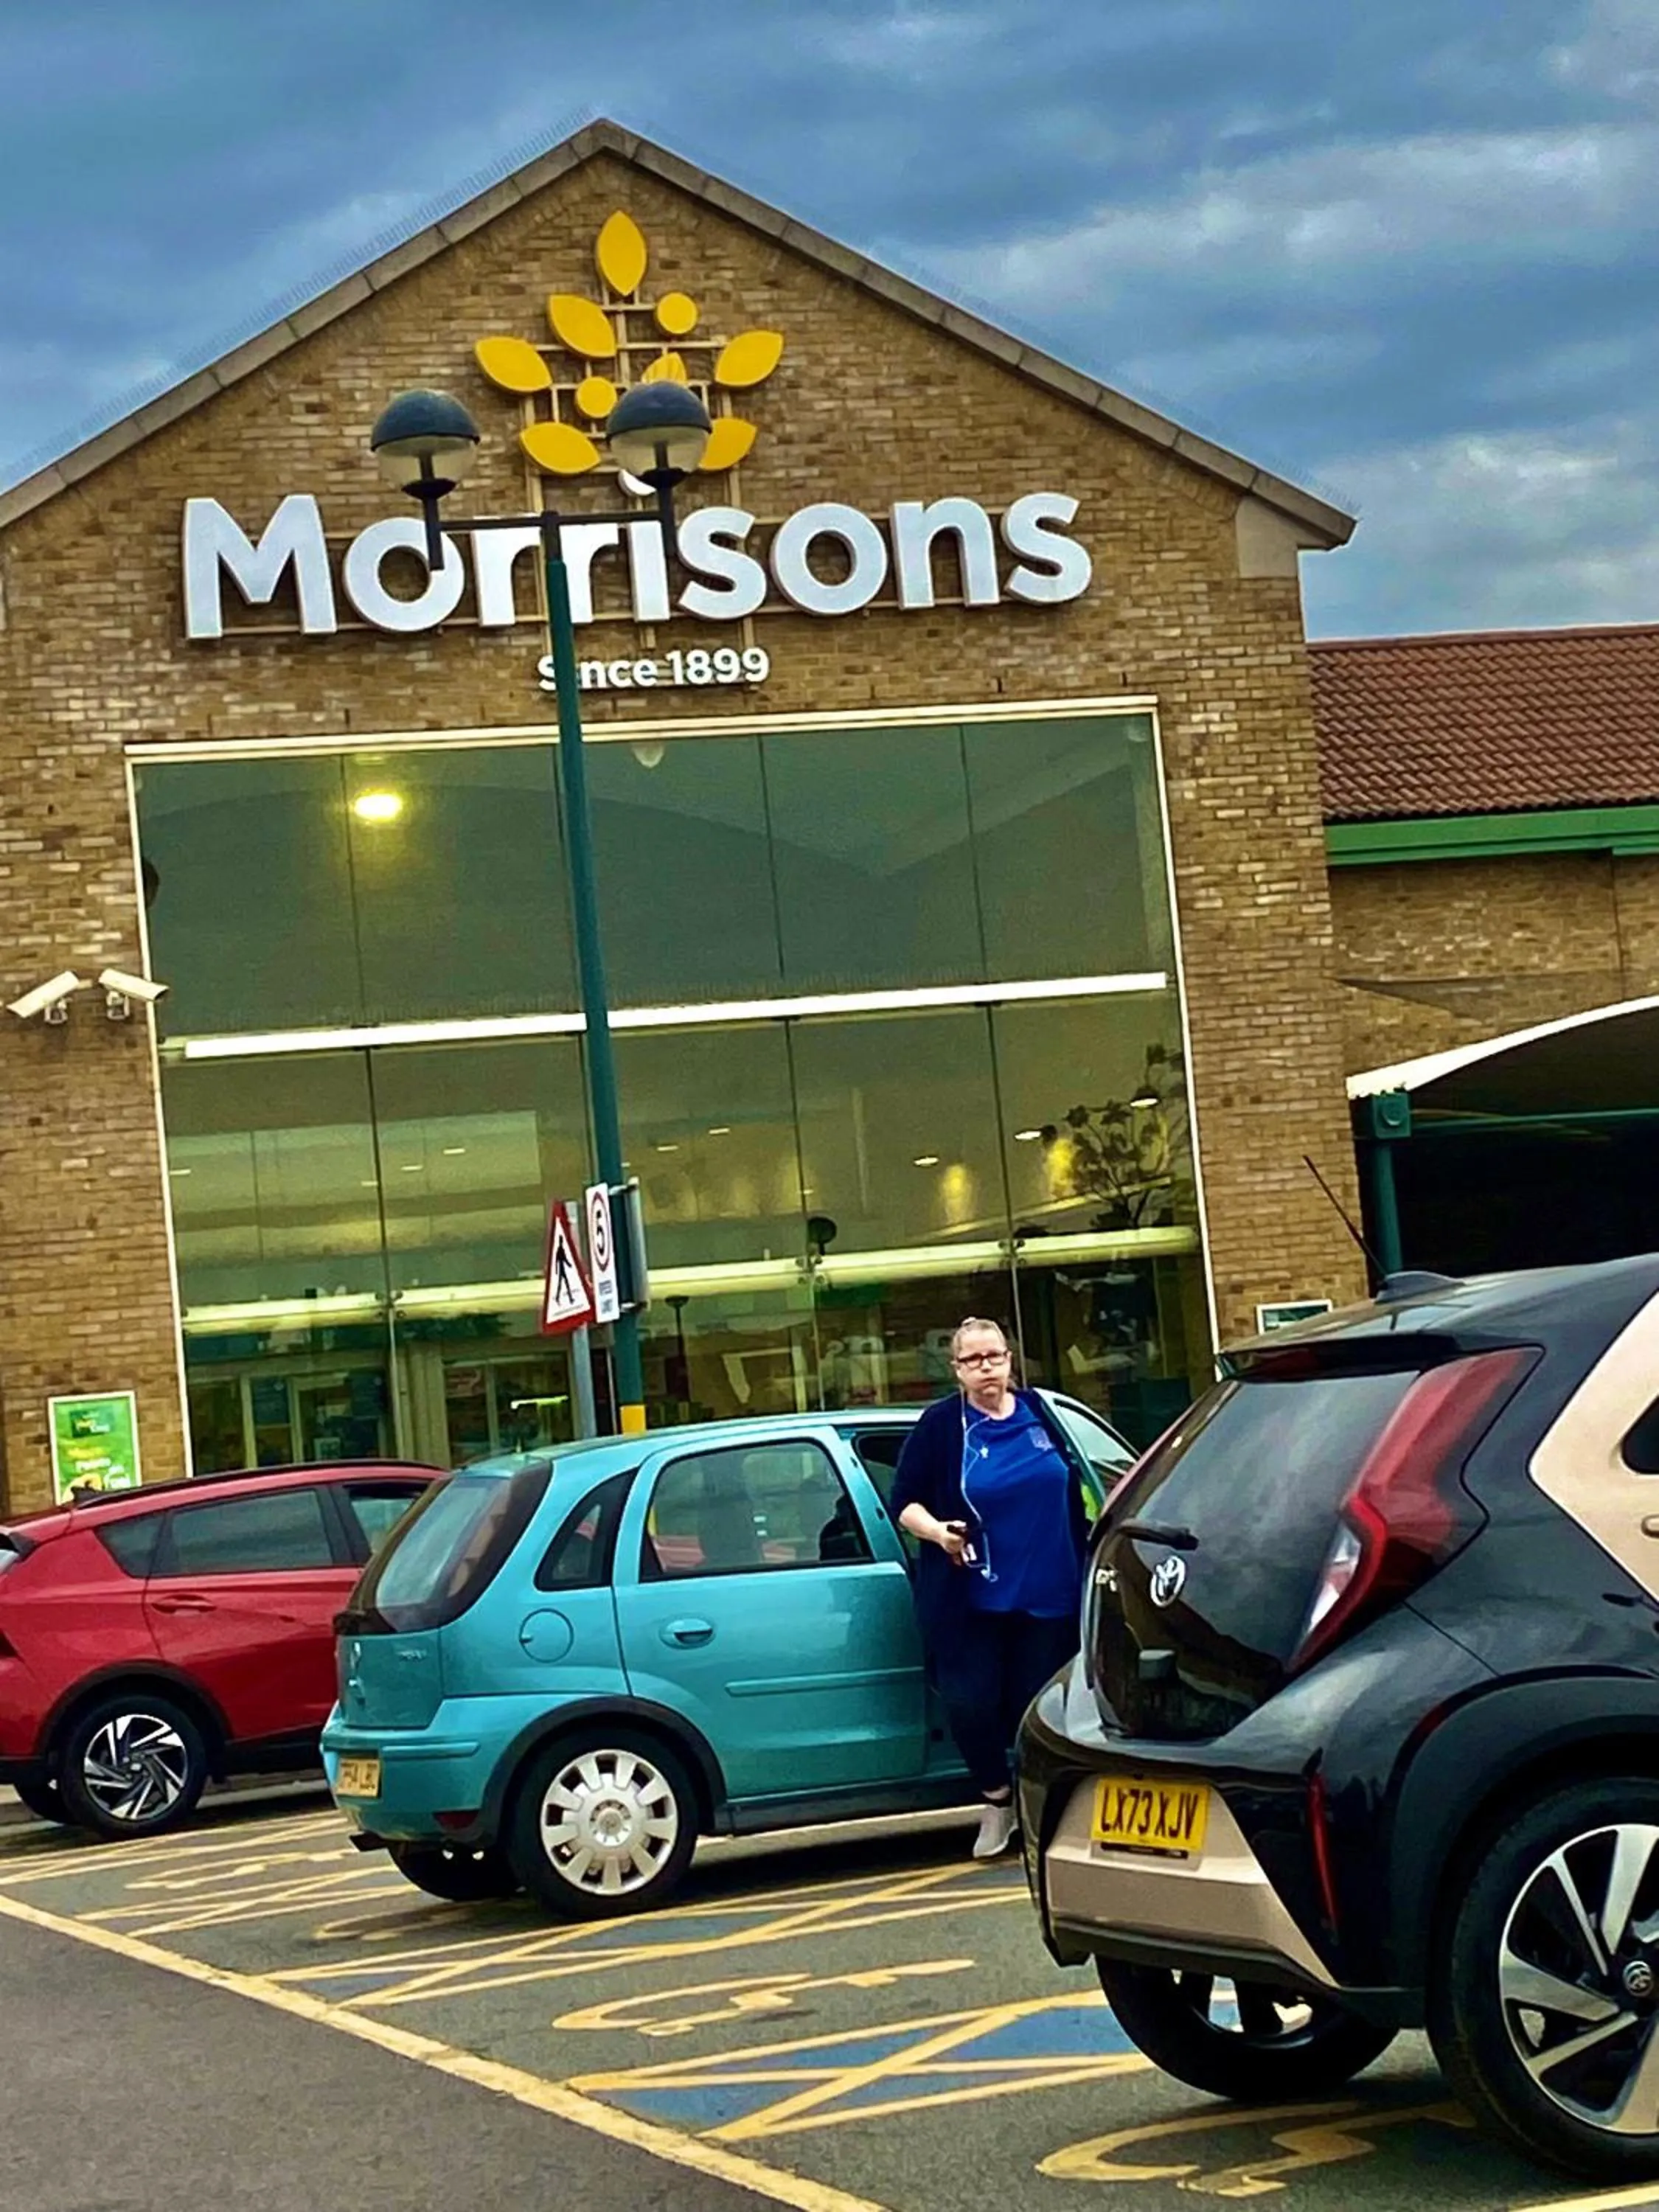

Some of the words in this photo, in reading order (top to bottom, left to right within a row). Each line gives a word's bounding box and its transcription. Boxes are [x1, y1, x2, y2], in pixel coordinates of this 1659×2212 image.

[183, 470, 1093, 639] Morrisons
[538, 654, 658, 691] Snce
[666, 647, 770, 686] 1899
[1101, 1787, 1153, 1834] LX73
[1154, 1791, 1199, 1840] XJV
